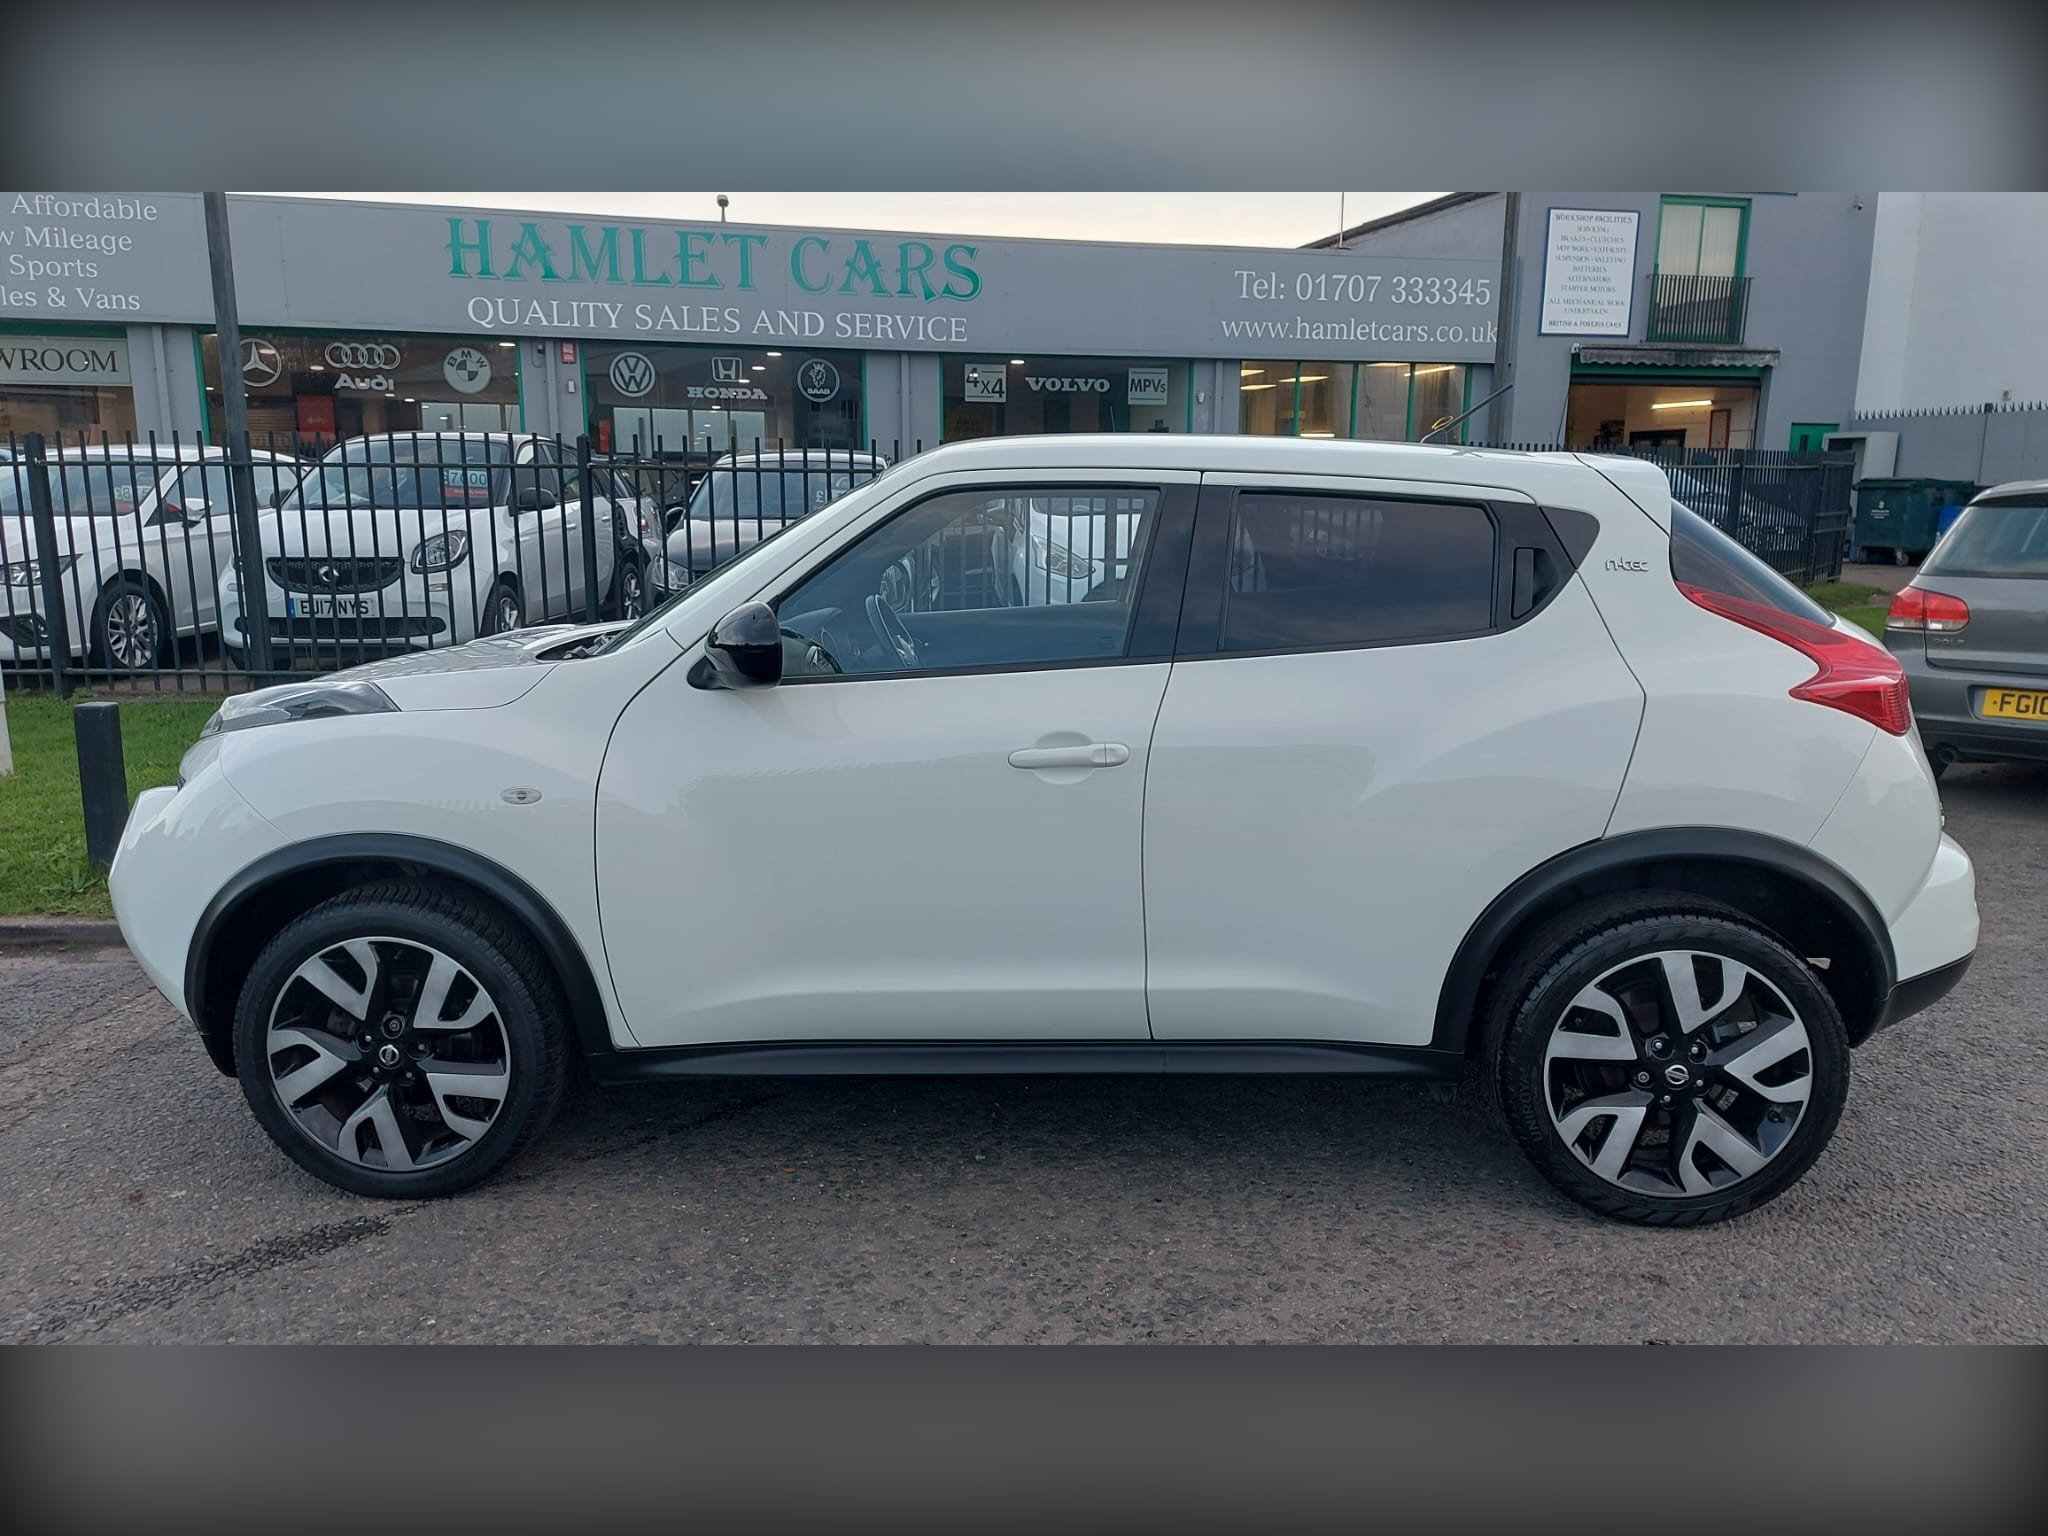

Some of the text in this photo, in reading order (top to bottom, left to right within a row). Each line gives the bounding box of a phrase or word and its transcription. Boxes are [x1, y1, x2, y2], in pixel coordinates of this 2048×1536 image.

[11, 193, 158, 221] Affordable
[24, 226, 133, 255] Mileage
[9, 253, 98, 280] Sports
[444, 217, 983, 304] HAMLET CARS
[47, 286, 67, 308] &
[75, 287, 141, 311] Vans
[1234, 270, 1491, 306] Tel: 01707 333345
[467, 297, 968, 342] QUALITY SALES AND SERVICE
[1221, 316, 1498, 344] www.hamletcars.co.uk
[447, 350, 488, 368] BMW
[334, 373, 395, 391] Audi
[687, 386, 767, 400] HONDA
[965, 367, 1006, 398] 4x4
[1025, 376, 1111, 393] VOLVO
[1129, 377, 1166, 394] MPVs
